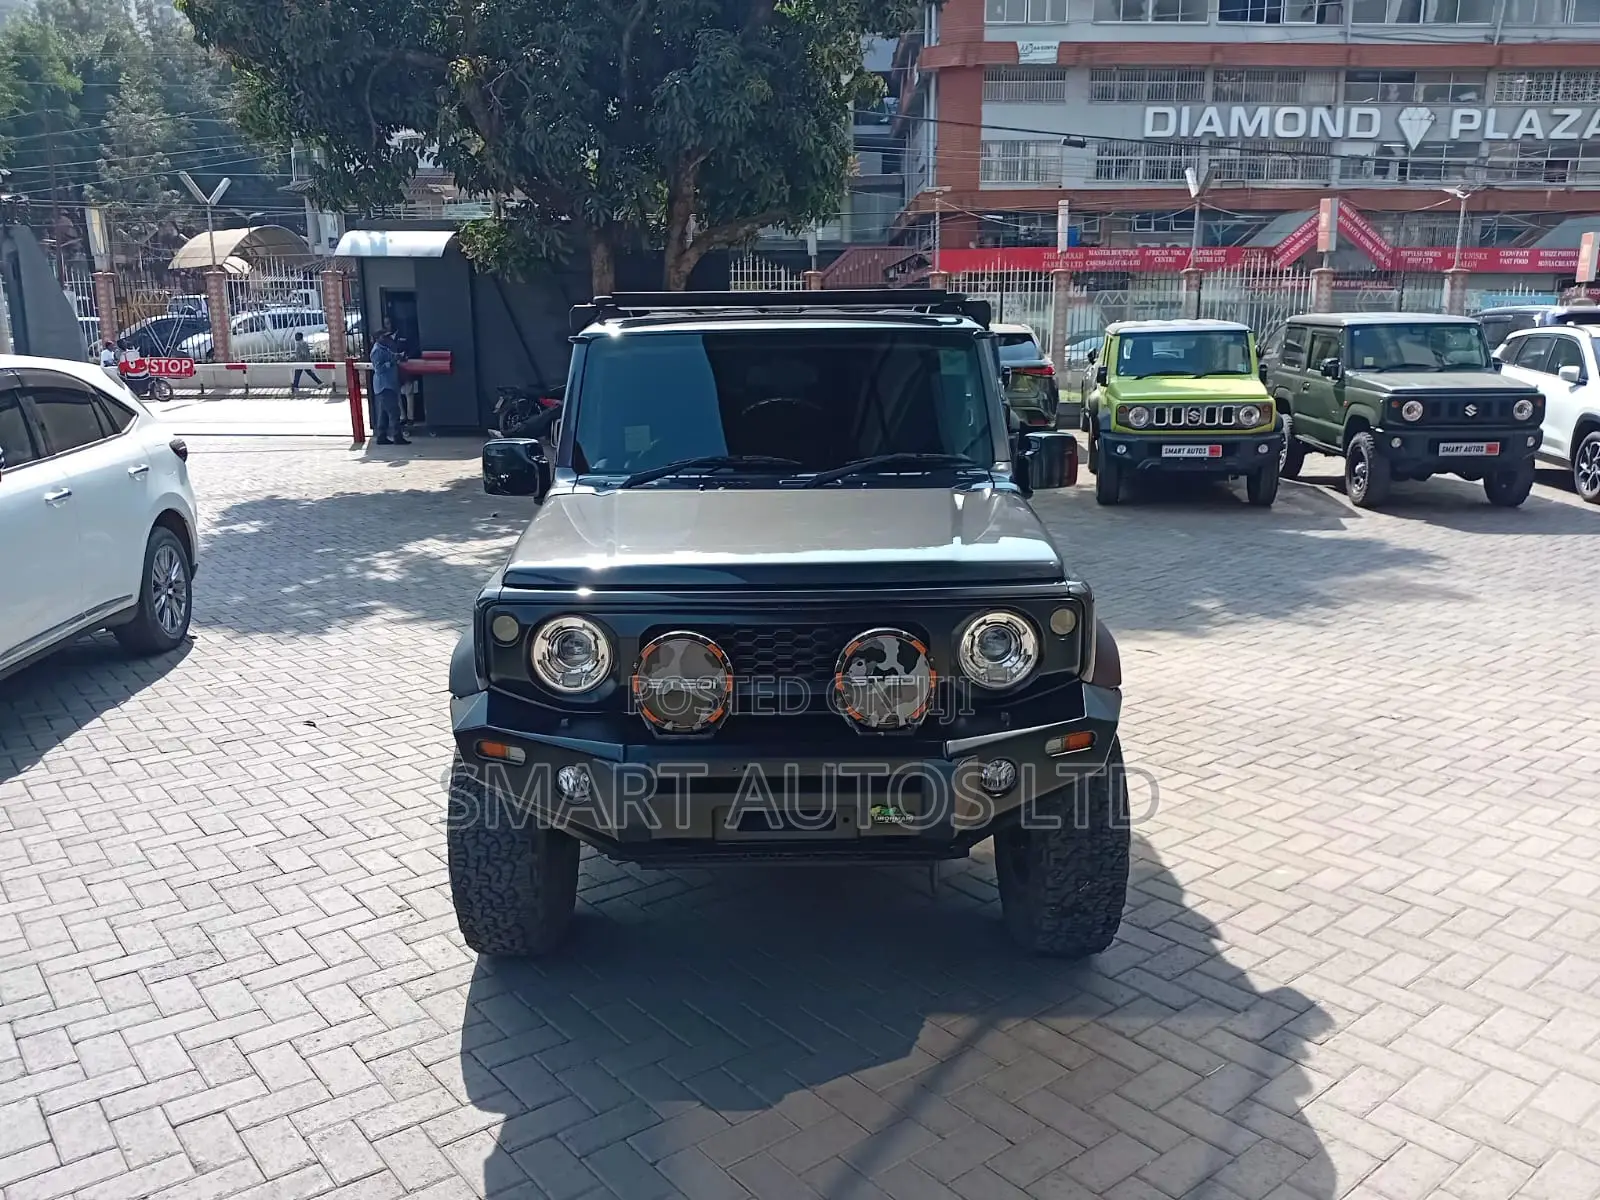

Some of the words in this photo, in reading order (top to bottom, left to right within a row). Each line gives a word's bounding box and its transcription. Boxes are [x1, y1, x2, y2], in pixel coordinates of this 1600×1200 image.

[1144, 106, 1381, 139] DIAMOND
[1450, 108, 1600, 140] PLAZA
[150, 359, 191, 373] STOP
[1164, 447, 1185, 455] SMART
[1186, 447, 1207, 455] AUTOS
